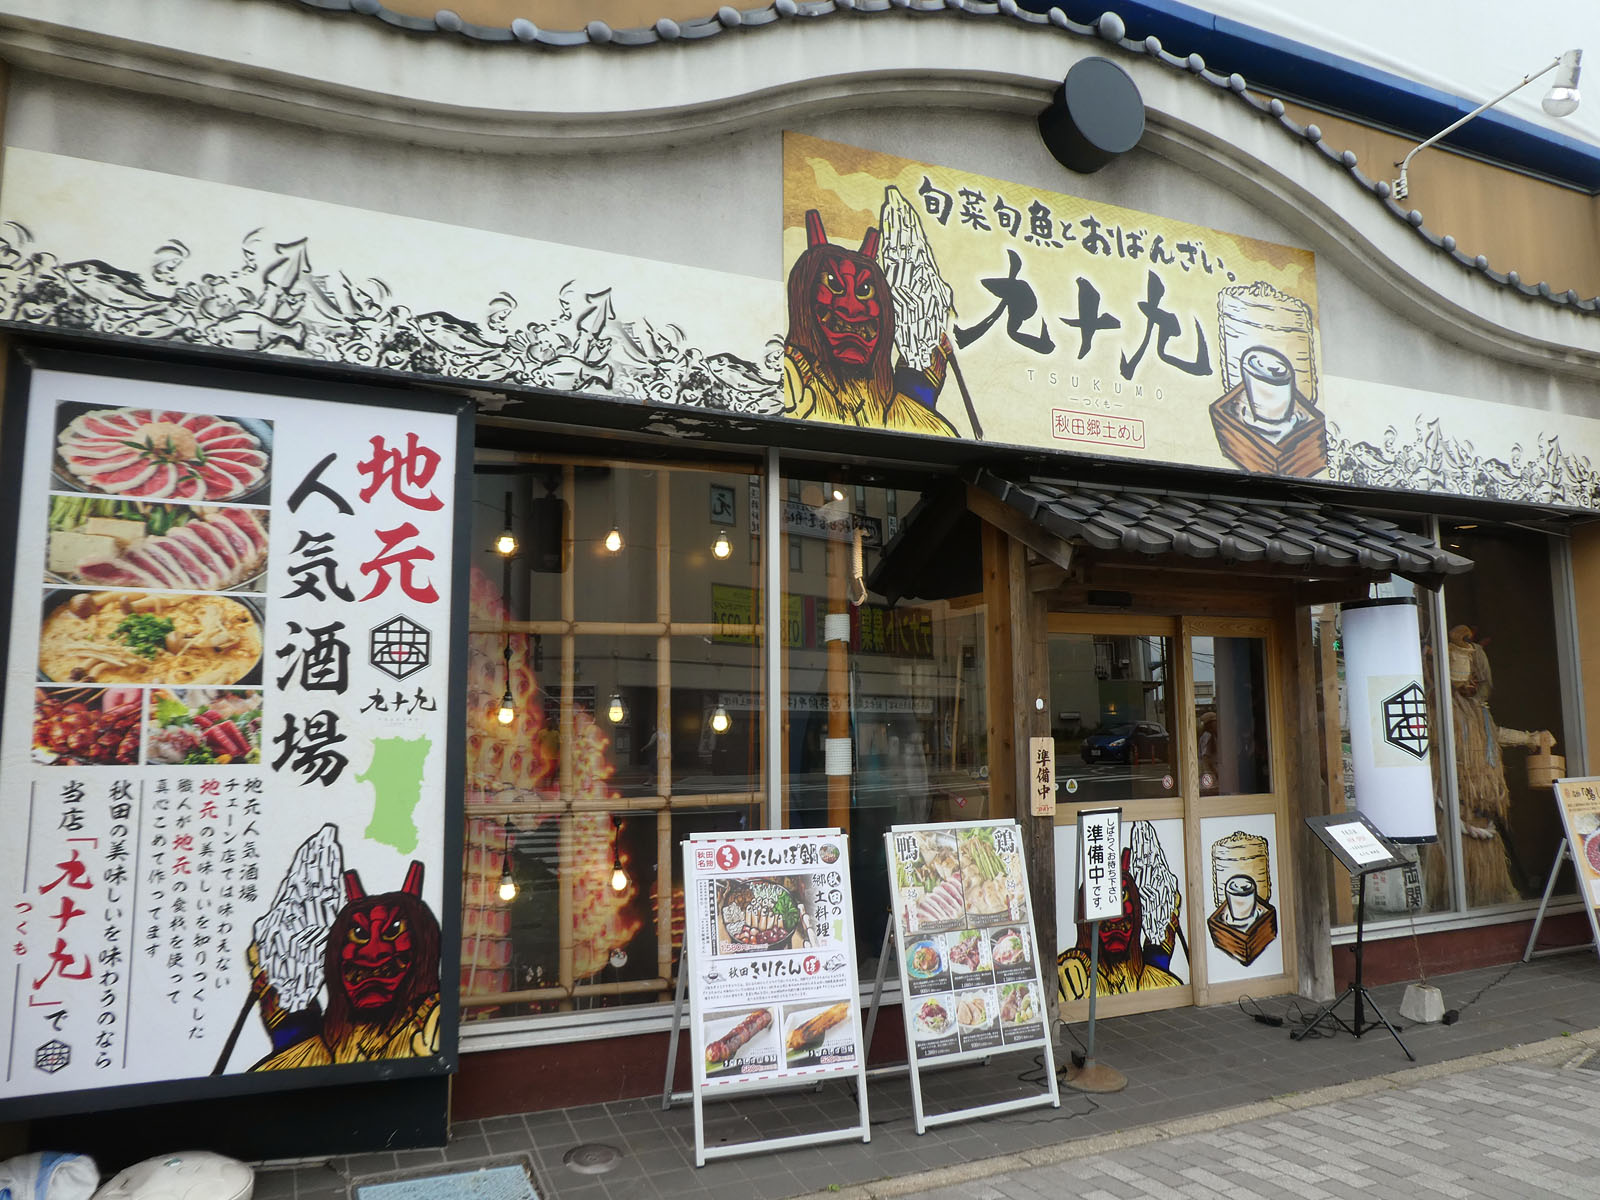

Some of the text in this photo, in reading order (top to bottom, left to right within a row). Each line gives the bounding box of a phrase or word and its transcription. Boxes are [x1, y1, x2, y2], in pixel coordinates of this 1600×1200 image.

[918, 176, 1237, 282] 旬菜旬魚とおばんざい。
[953, 250, 1213, 381] 九十九
[1027, 369, 1163, 400] TSUKUMO
[1055, 414, 1143, 442] 秋田郷土めし
[356, 432, 446, 604] 地元
[271, 452, 356, 788] 人気酒場
[360, 687, 438, 714] 九十九
[1036, 749, 1051, 800] 準備中
[145, 778, 170, 958] 真心こめて作ってます
[215, 778, 240, 989] チェーン店では味わえない
[238, 778, 263, 903] 地元人気酒場
[697, 851, 714, 859] 秋田
[719, 843, 819, 868] きりたんぽ鍋
[1087, 824, 1105, 911] 準備中です。
[1107, 818, 1118, 904] しばらくお待ち下さい
[13, 902, 33, 956] つくも
[94, 780, 134, 1069] 秋田の美味しいを味わうのなら
[812, 873, 830, 938] 郷土料理
